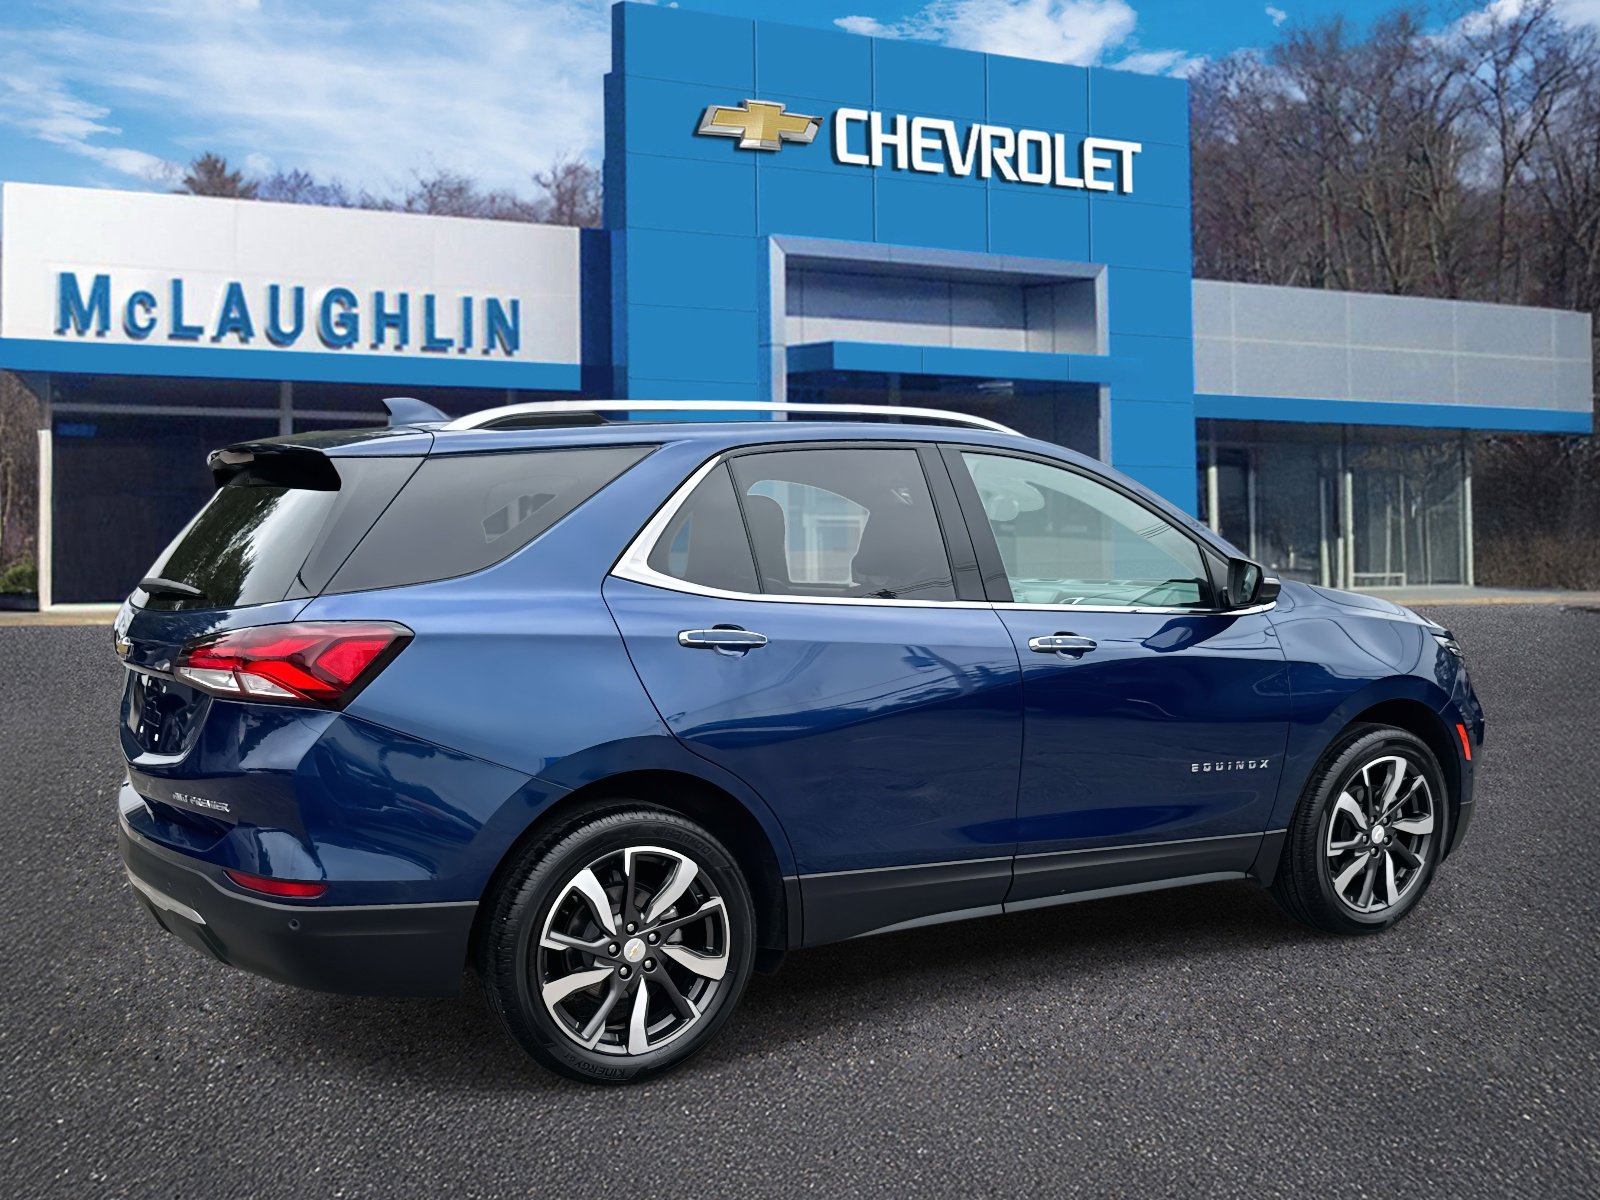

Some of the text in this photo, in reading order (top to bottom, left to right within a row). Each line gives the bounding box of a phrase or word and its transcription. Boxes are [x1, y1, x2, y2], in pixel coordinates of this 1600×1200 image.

[834, 107, 1142, 193] CHEVROLET
[55, 271, 520, 355] McLAUGHLIN
[1191, 759, 1269, 773] EQUINOX
